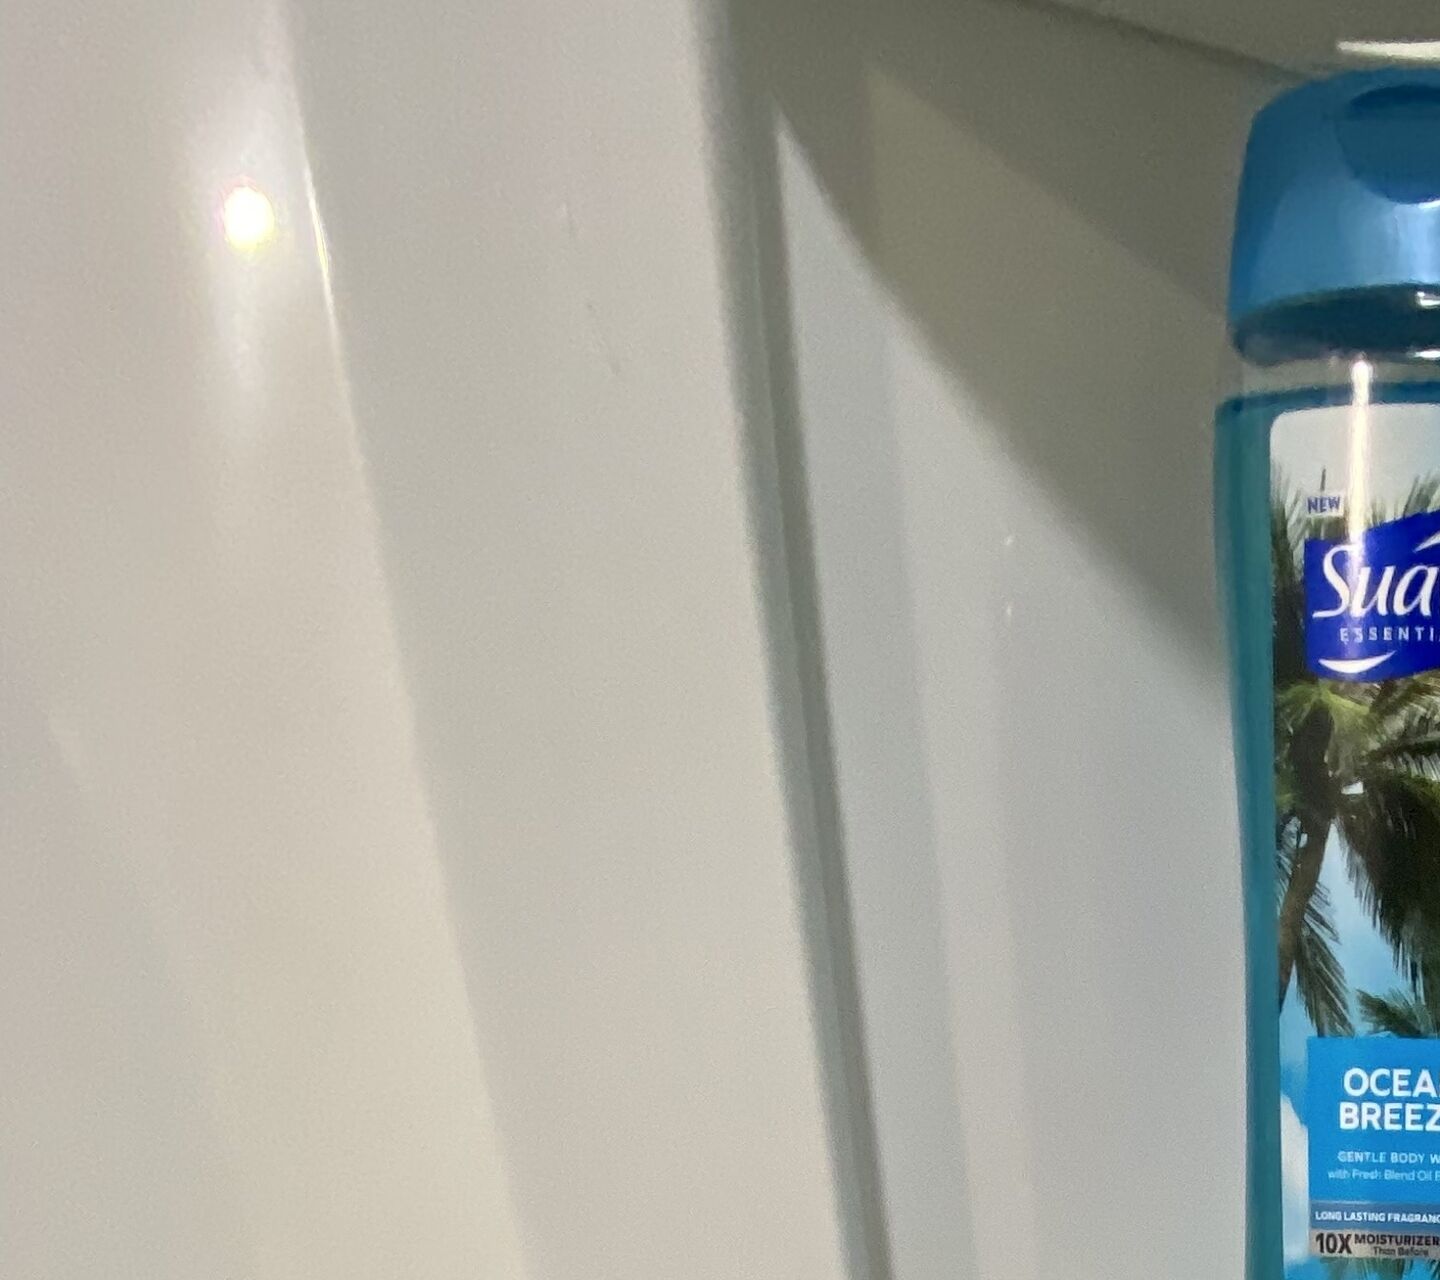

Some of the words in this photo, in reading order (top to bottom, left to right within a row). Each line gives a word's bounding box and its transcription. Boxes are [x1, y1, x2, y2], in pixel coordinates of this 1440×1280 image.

[1307, 496, 1341, 515] NEW
[1337, 1151, 1387, 1164] GENTLE
[1390, 1152, 1425, 1164] BODY
[1417, 1170, 1432, 1182] Oil
[1315, 1211, 1342, 1221] LONG
[1344, 1211, 1386, 1222] LASTING
[1315, 1232, 1352, 1254] 10X
